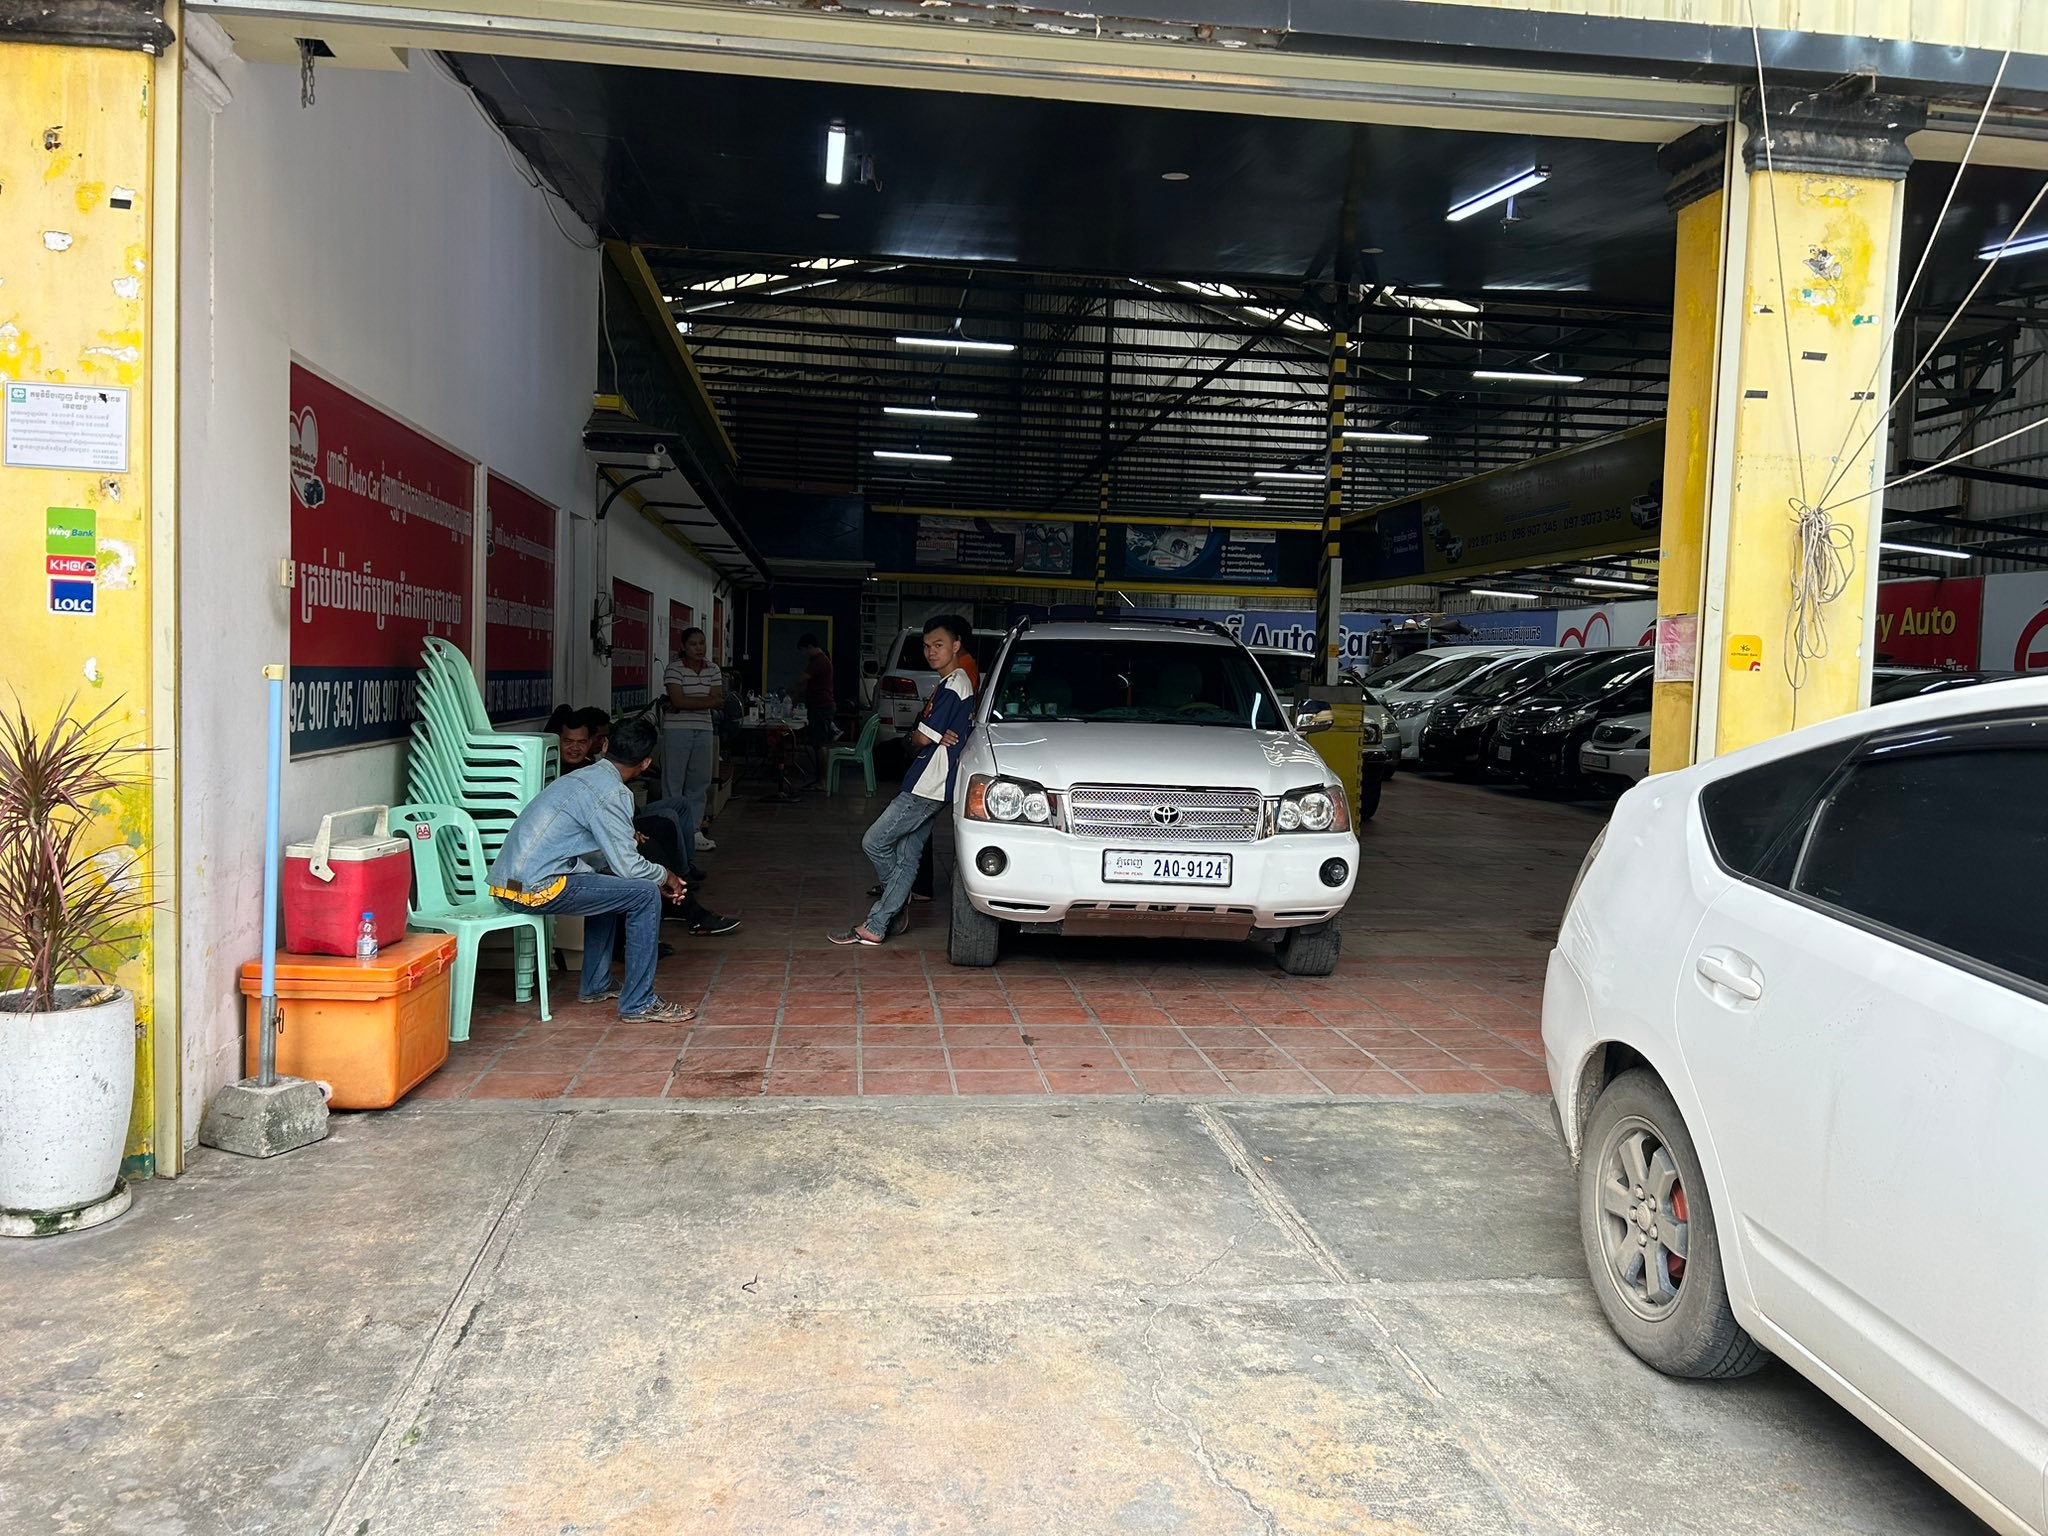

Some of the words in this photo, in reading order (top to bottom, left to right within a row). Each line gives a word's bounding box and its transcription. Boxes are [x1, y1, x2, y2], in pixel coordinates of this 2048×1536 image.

[348, 463, 367, 498] Auto
[368, 471, 380, 502] Car
[48, 525, 71, 538] Wing
[71, 528, 94, 537] Bank
[54, 598, 92, 612] LOLC
[1899, 606, 1956, 636] Auto
[1252, 625, 1317, 654] Auto
[309, 681, 331, 731] 907
[333, 681, 353, 728] 345
[362, 680, 380, 725] 098
[382, 680, 399, 722] 907
[401, 680, 416, 720] 345
